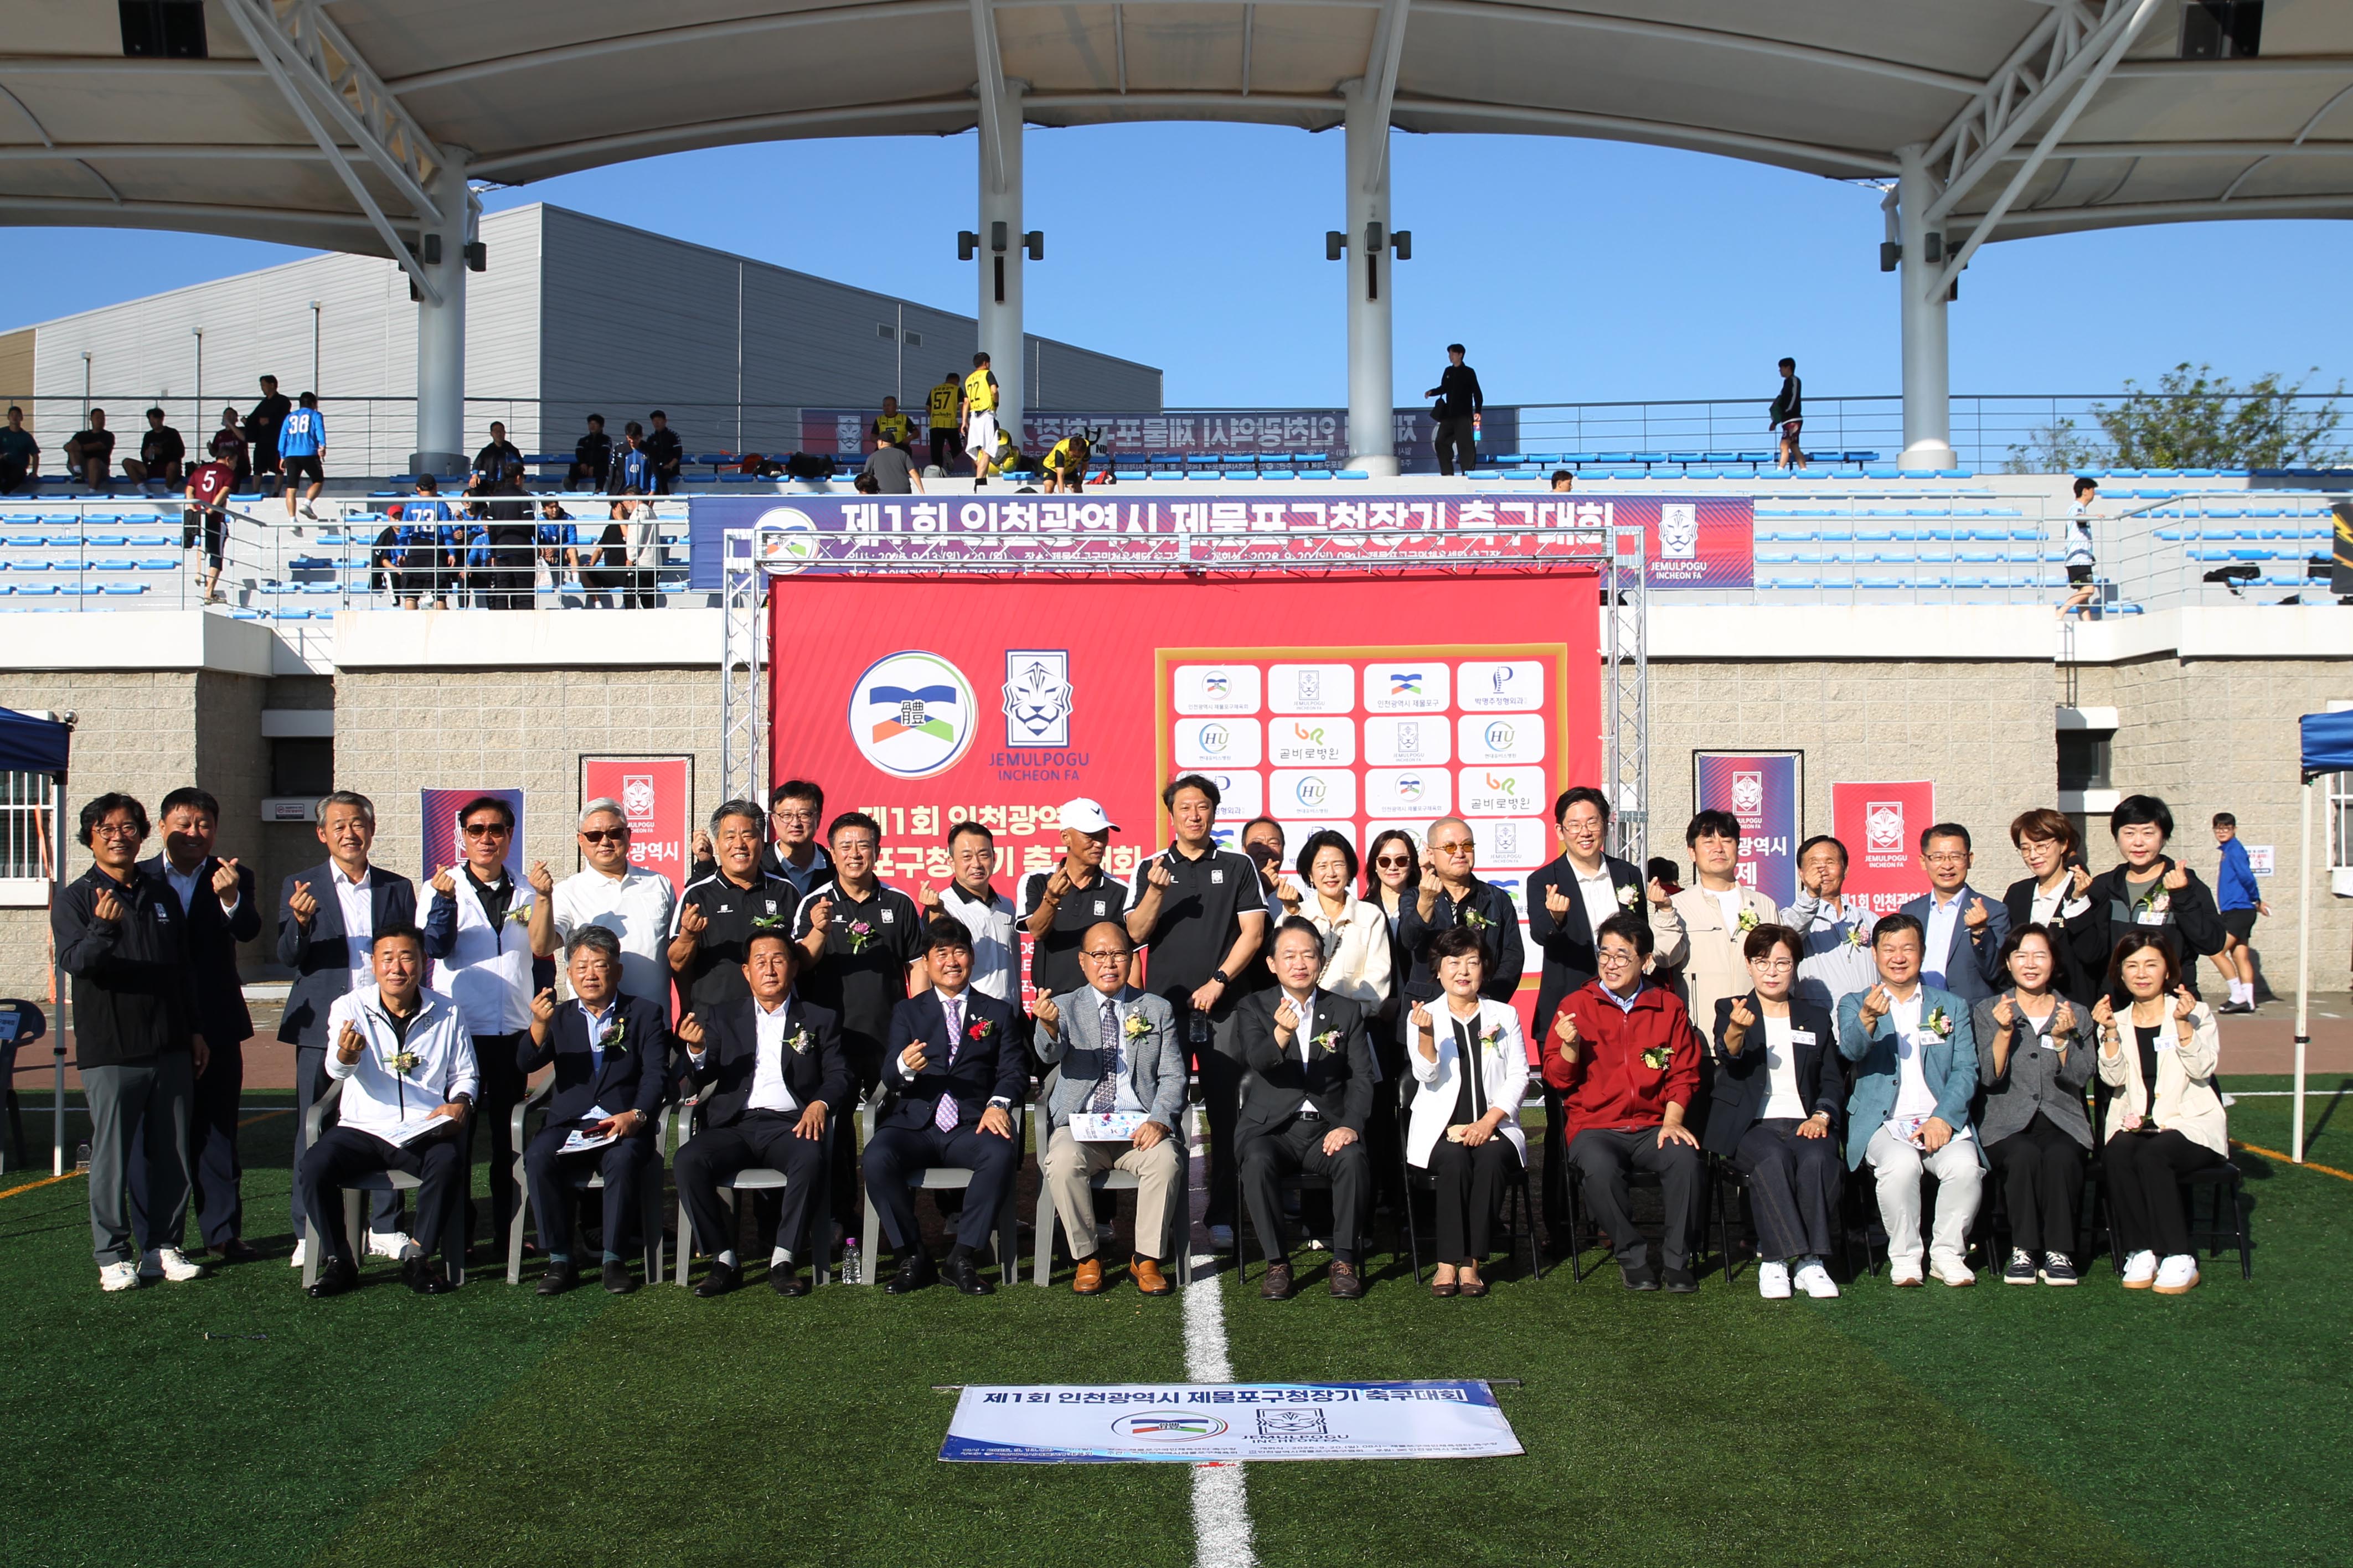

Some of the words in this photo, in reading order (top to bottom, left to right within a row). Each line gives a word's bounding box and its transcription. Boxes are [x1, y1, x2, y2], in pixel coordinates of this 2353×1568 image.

[933, 391, 951, 410] 57
[289, 414, 309, 434] 38
[202, 470, 216, 492] 5
[411, 509, 435, 532] 73
[841, 503, 948, 547] 제1회
[960, 502, 1158, 547] 인천광역시
[1170, 501, 1446, 547] 제물포구청장기
[1458, 500, 1614, 546] 축구대회
[1651, 562, 1707, 571] JEMULPOGU
[1693, 571, 1702, 579] FA
[1377, 700, 1411, 708] 인천광역시
[988, 753, 1090, 767] JEMULPOGU
[1280, 748, 1339, 760] 곧바로병원
[998, 770, 1059, 781] INCHEON
[1062, 770, 1080, 781] FA
[1471, 798, 1530, 810] 곧바로병원
[948, 805, 1062, 836] 인천광역
[630, 841, 678, 862] 광역시
[1738, 836, 1787, 857] 광역시
[983, 1392, 1050, 1404] 제1회
[1059, 1392, 1179, 1404] 인천광역시
[1188, 1389, 1359, 1404] 제물포구청장기
[1365, 1388, 1469, 1401] 축구대회
